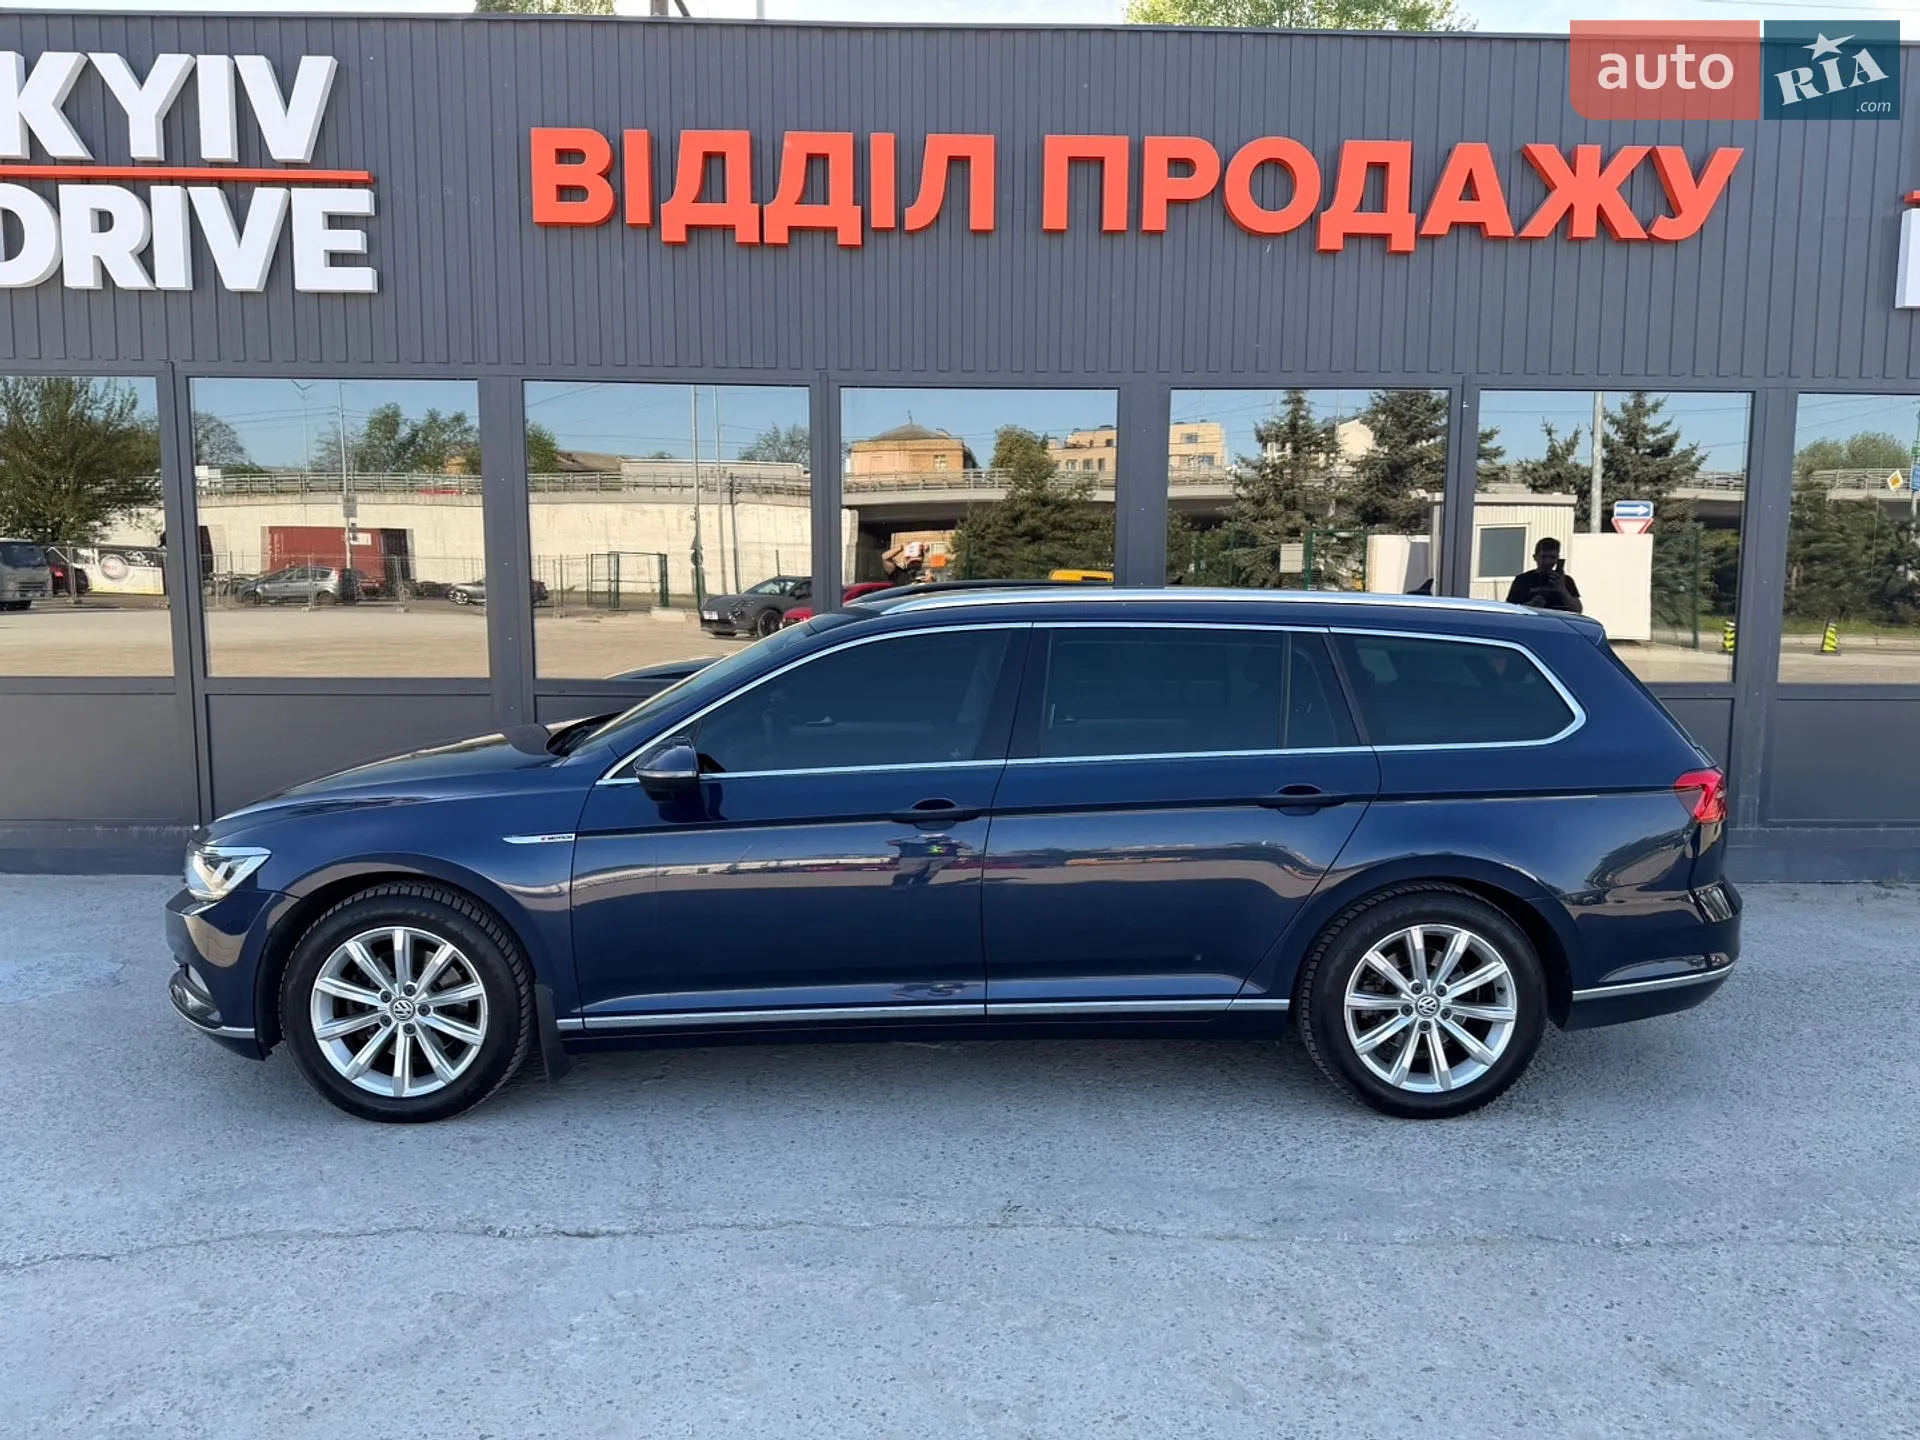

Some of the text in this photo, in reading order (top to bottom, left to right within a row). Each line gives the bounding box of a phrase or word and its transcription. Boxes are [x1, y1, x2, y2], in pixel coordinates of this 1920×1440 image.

[0, 51, 338, 163] KYIV
[0, 183, 379, 293] DRIVE
[530, 126, 1745, 254] ВІДДІЛ ПРОДАЖУ
